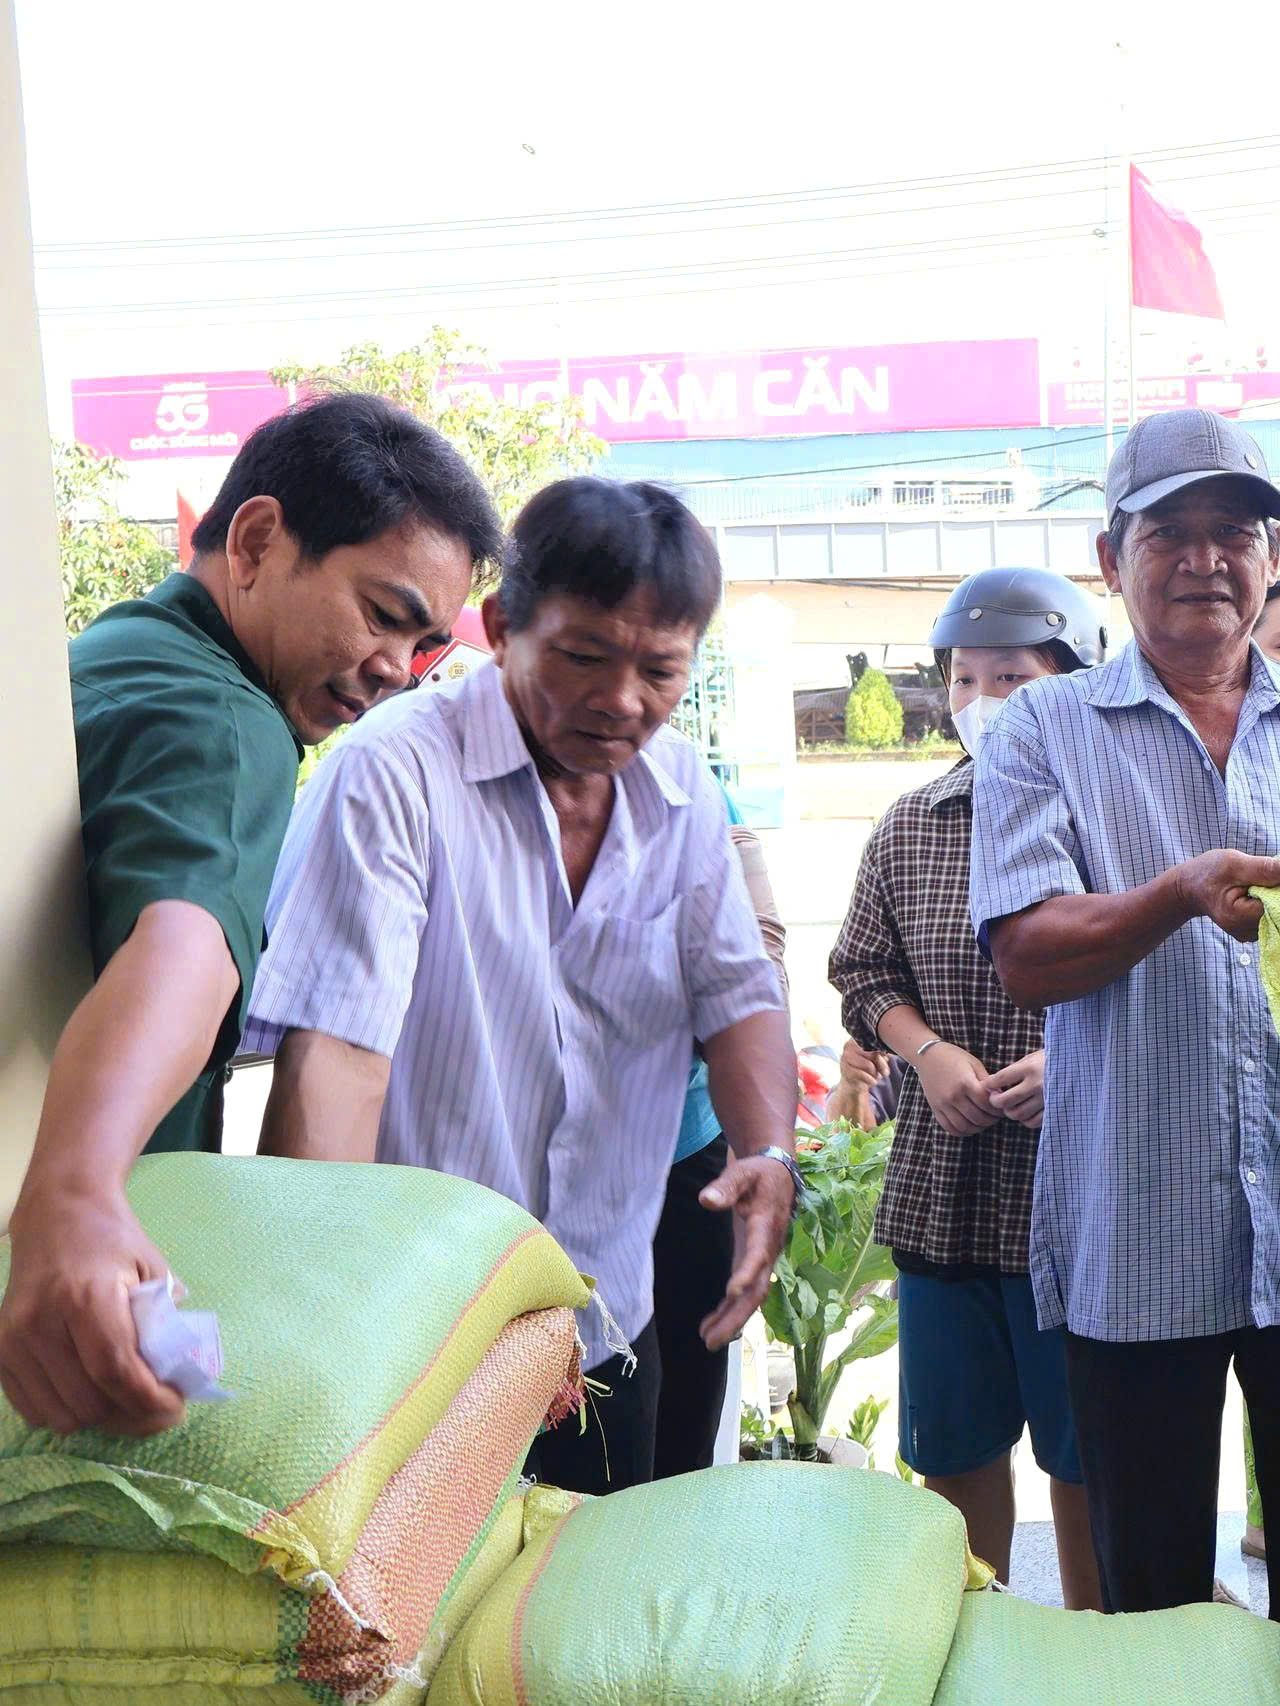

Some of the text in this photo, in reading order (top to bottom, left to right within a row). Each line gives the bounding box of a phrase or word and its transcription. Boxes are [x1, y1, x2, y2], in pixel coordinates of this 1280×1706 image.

[156, 393, 209, 432] 5G
[582, 361, 737, 425] NĂM
[752, 355, 889, 417] CĂN
